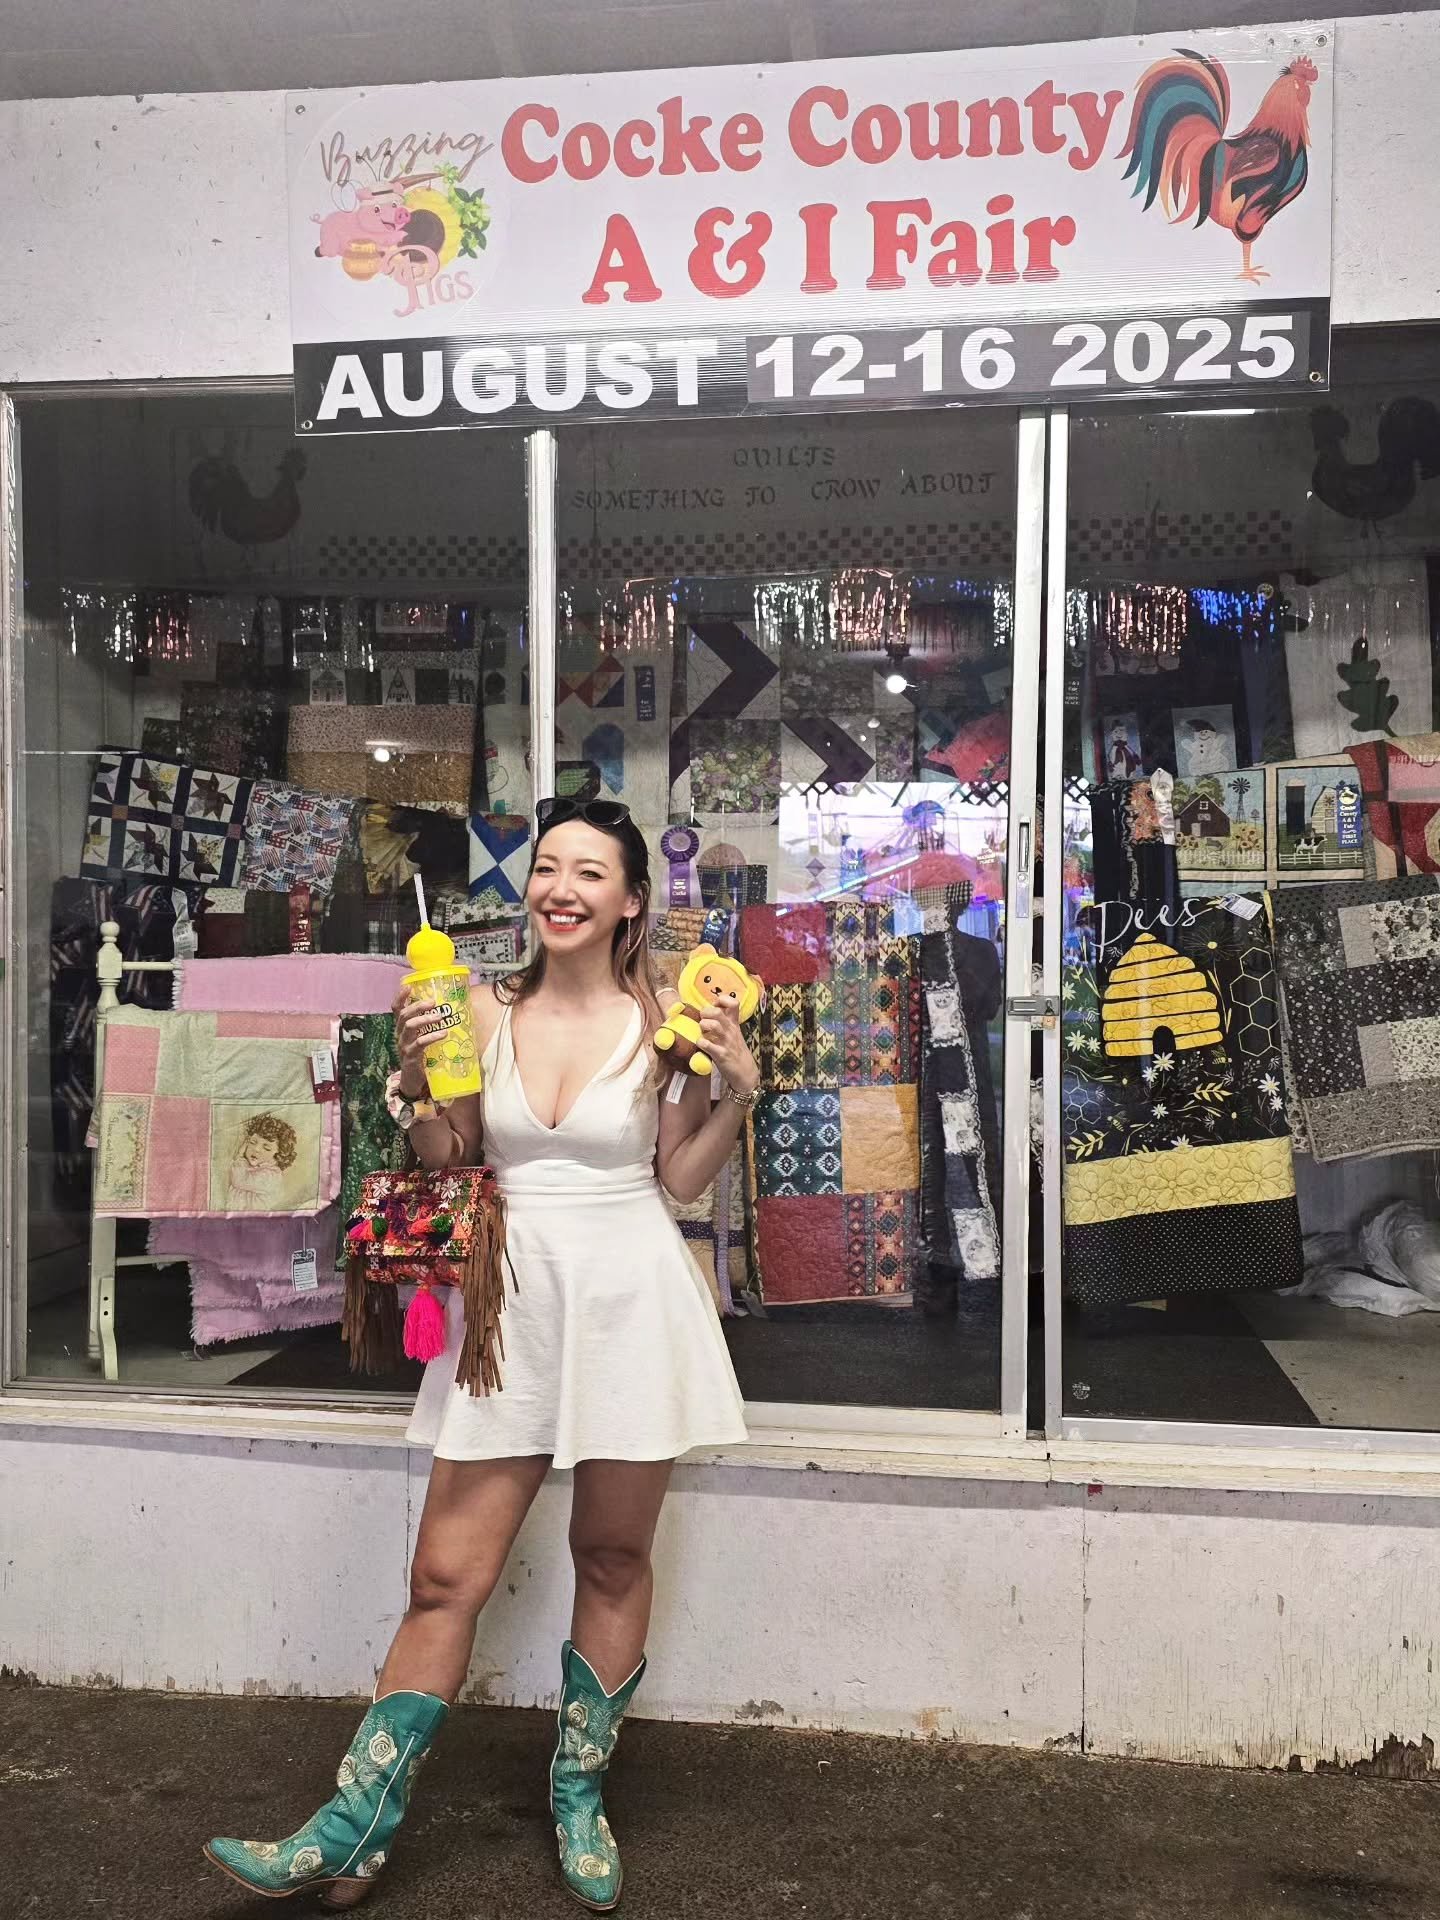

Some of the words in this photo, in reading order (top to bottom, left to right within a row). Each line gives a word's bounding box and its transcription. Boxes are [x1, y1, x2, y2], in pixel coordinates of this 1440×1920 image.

[320, 130, 496, 188] Buzzing
[503, 95, 765, 184] Cocke
[789, 80, 1125, 172] County
[582, 213, 663, 305] A
[688, 206, 773, 299] &
[800, 203, 838, 293] I
[866, 194, 1077, 289] Fair
[315, 336, 719, 421] AUGUST
[754, 327, 1016, 398] 12-16
[1050, 313, 1295, 388] 2025
[571, 488, 725, 511] SOMETHING
[745, 485, 776, 508] TO
[811, 477, 881, 501] CROW
[901, 472, 997, 496] ABOUT
